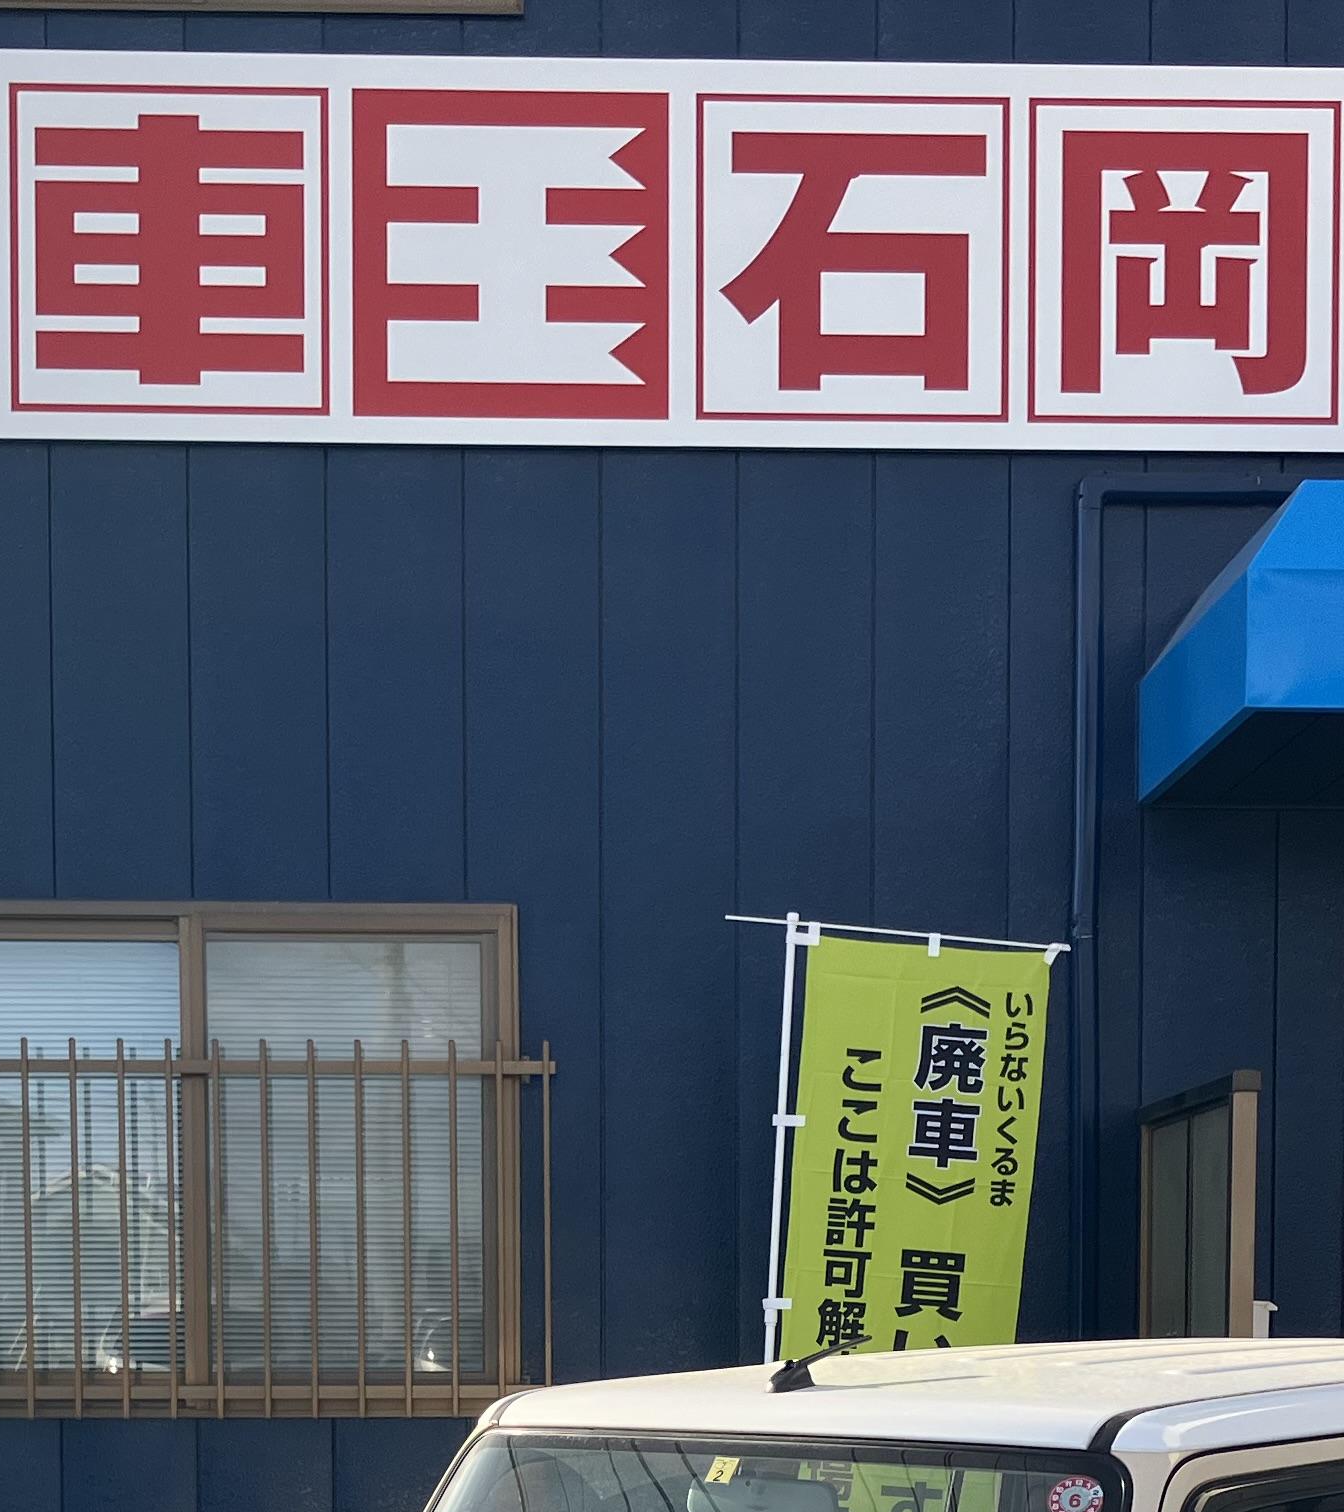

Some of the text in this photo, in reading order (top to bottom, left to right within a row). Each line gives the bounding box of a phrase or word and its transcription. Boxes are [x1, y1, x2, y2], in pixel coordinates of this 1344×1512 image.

[989, 991, 1034, 1208] いらないくるま
